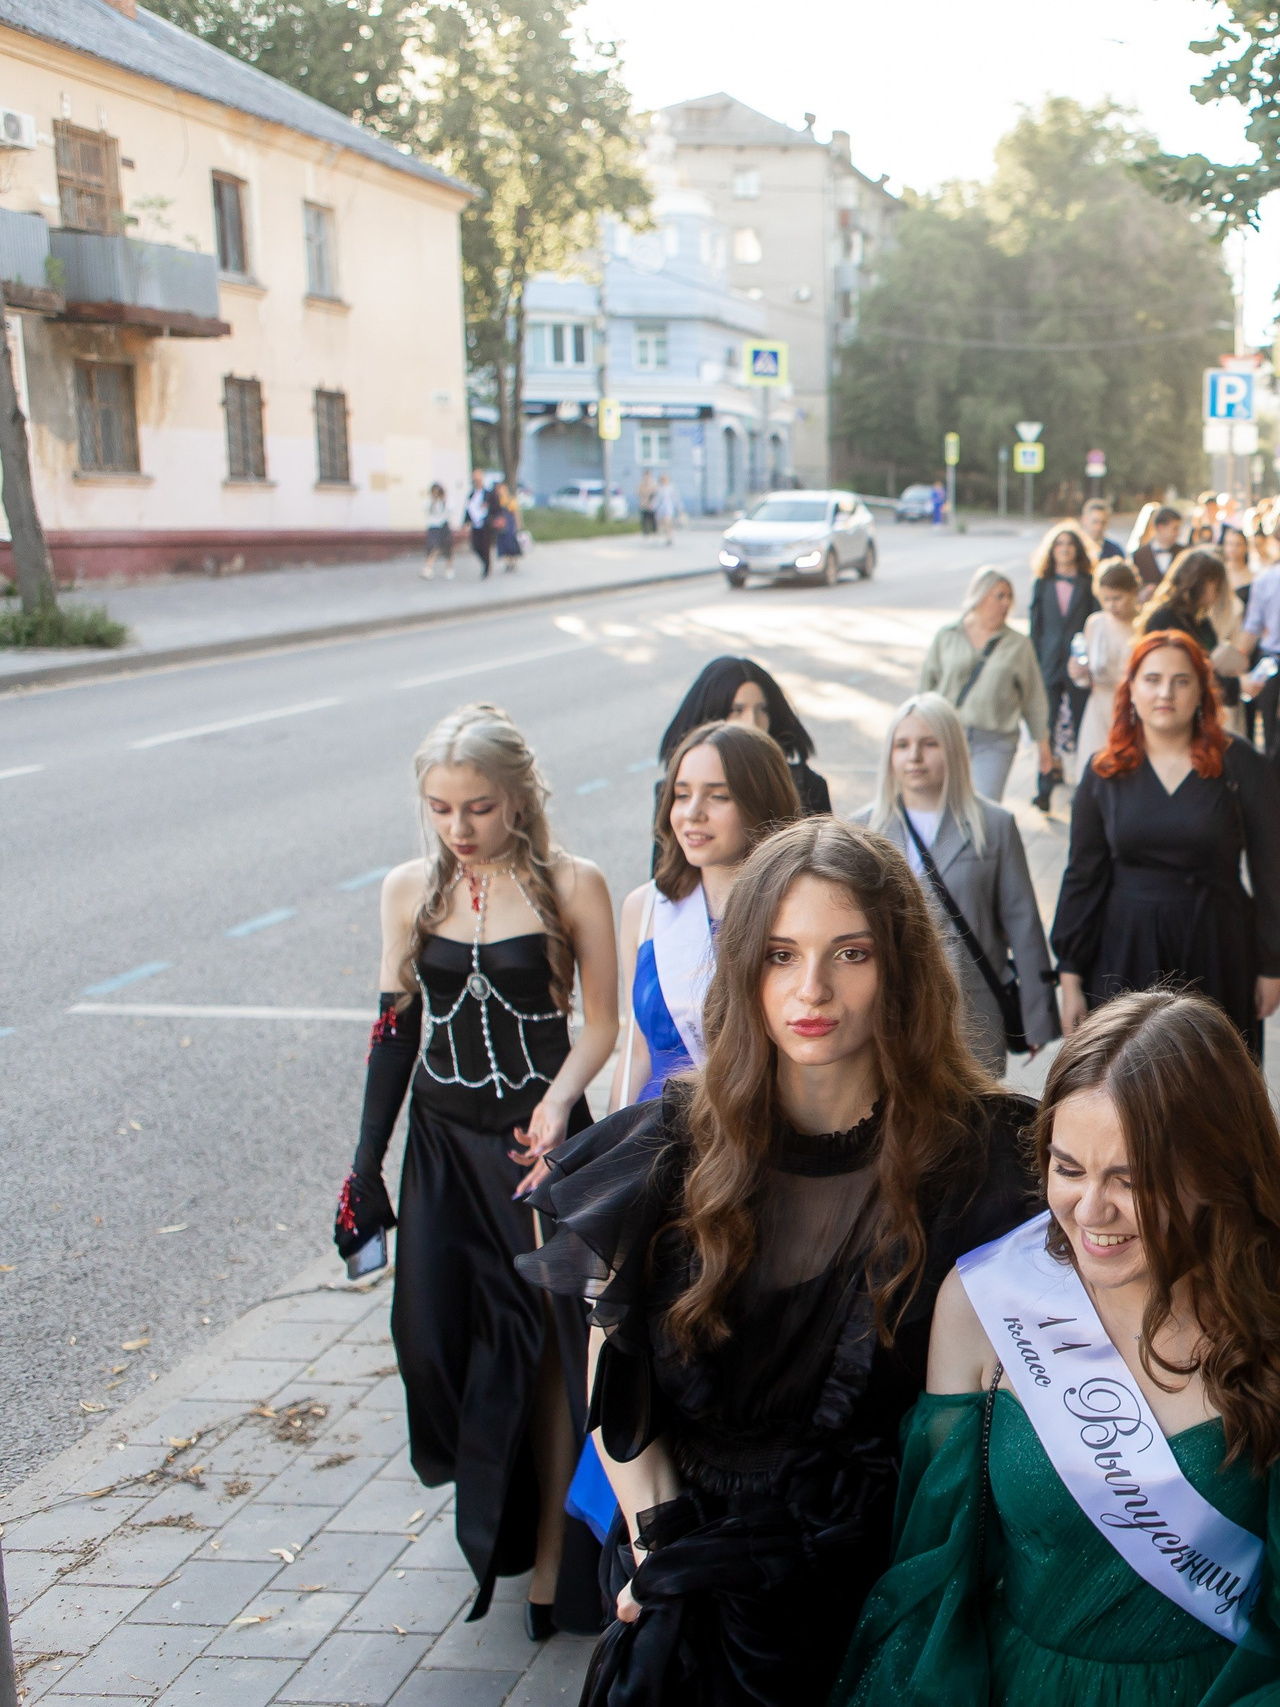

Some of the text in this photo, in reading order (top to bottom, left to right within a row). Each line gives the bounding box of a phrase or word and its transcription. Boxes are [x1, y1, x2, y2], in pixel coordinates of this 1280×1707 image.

[1217, 376, 1247, 416] P
[1002, 1317, 1052, 1388] класс
[1037, 1316, 1092, 1355] 11
